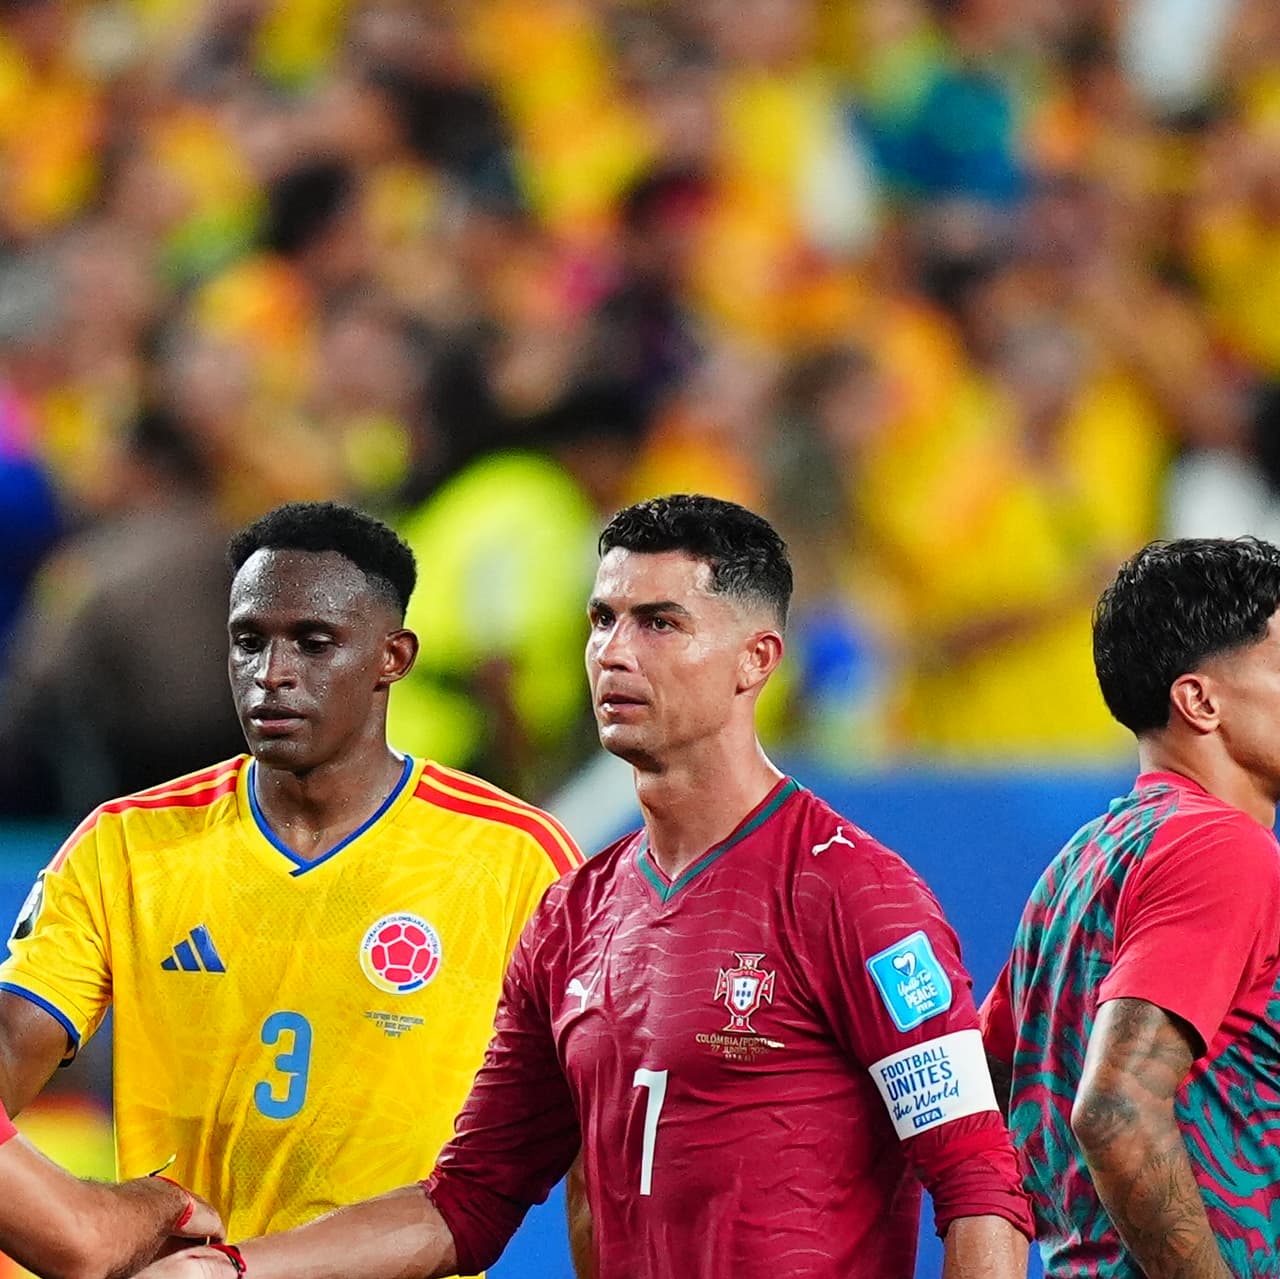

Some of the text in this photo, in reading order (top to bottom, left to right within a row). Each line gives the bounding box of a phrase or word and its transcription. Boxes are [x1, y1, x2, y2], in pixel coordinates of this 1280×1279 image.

[904, 982, 939, 1009] PEACE
[253, 1010, 313, 1120] 3
[880, 1046, 948, 1082] FOOTBALL
[886, 1060, 952, 1101] UNITES
[893, 1080, 960, 1121] the World
[914, 1108, 942, 1127] FIFA
[633, 1068, 668, 1195] 7
